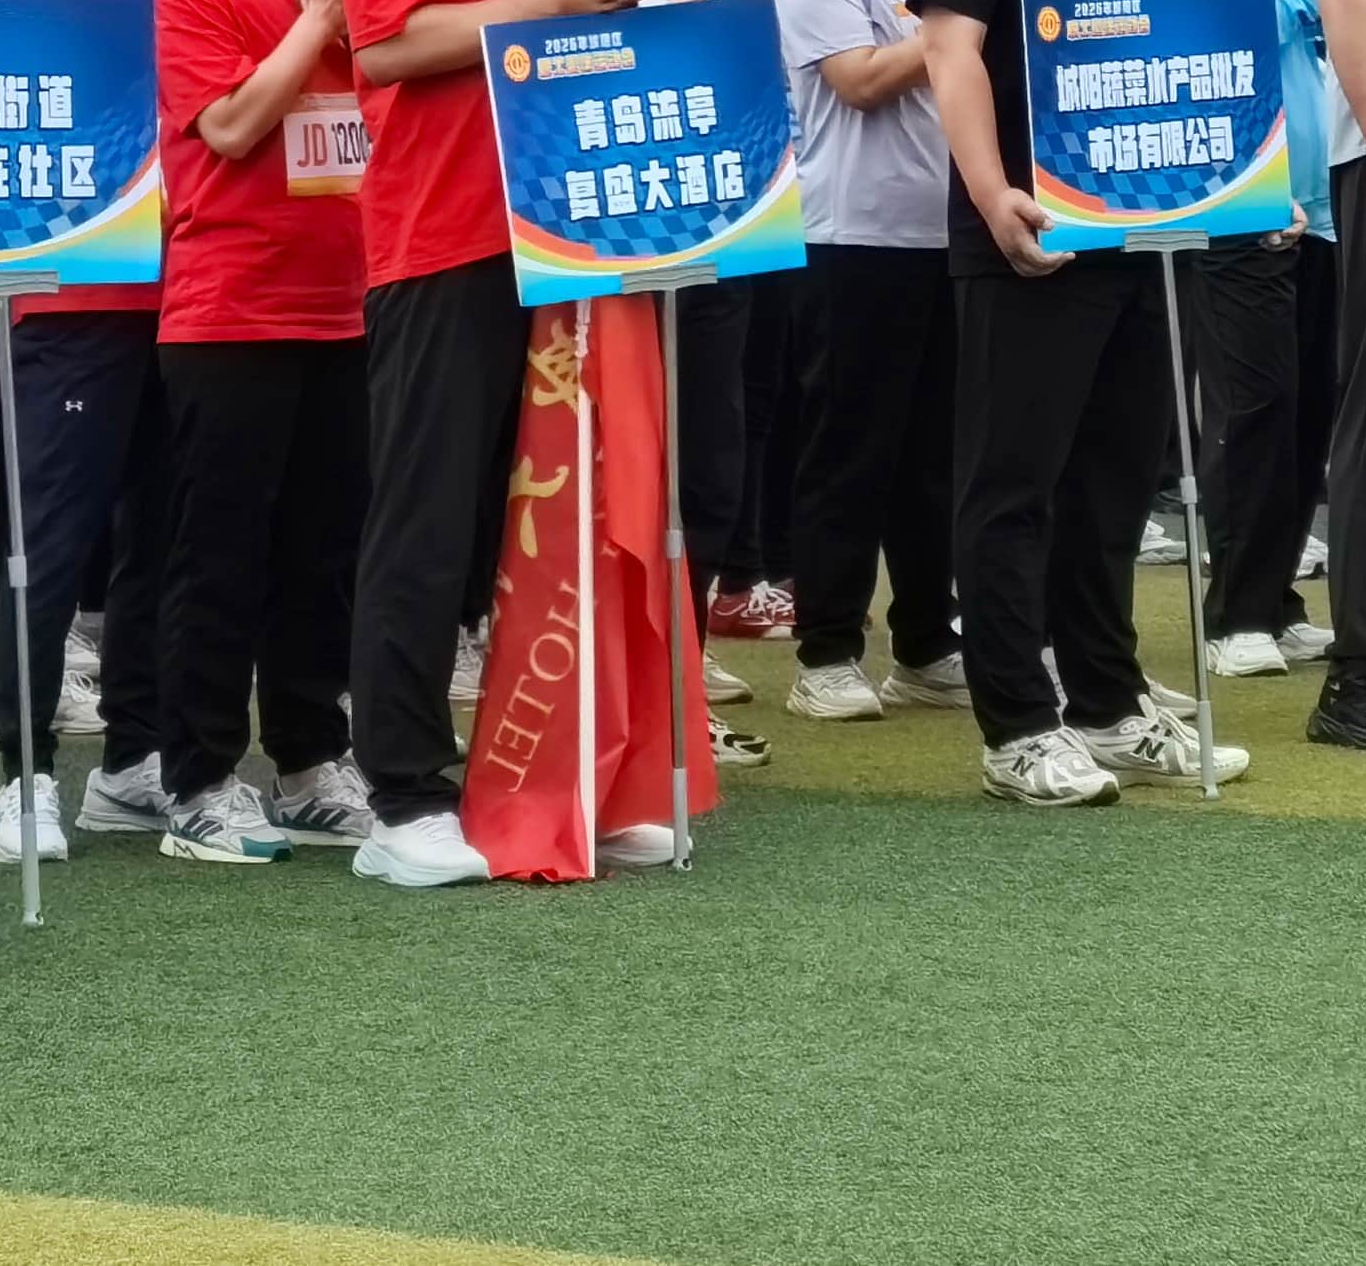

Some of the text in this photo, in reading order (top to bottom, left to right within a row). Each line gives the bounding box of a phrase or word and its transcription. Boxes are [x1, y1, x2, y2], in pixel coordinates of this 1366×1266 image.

[1056, 50, 1256, 112] 城阳蔬菜水产品批发
[573, 85, 718, 151] 青岛流亭
[1088, 116, 1235, 174] 市场有限公司
